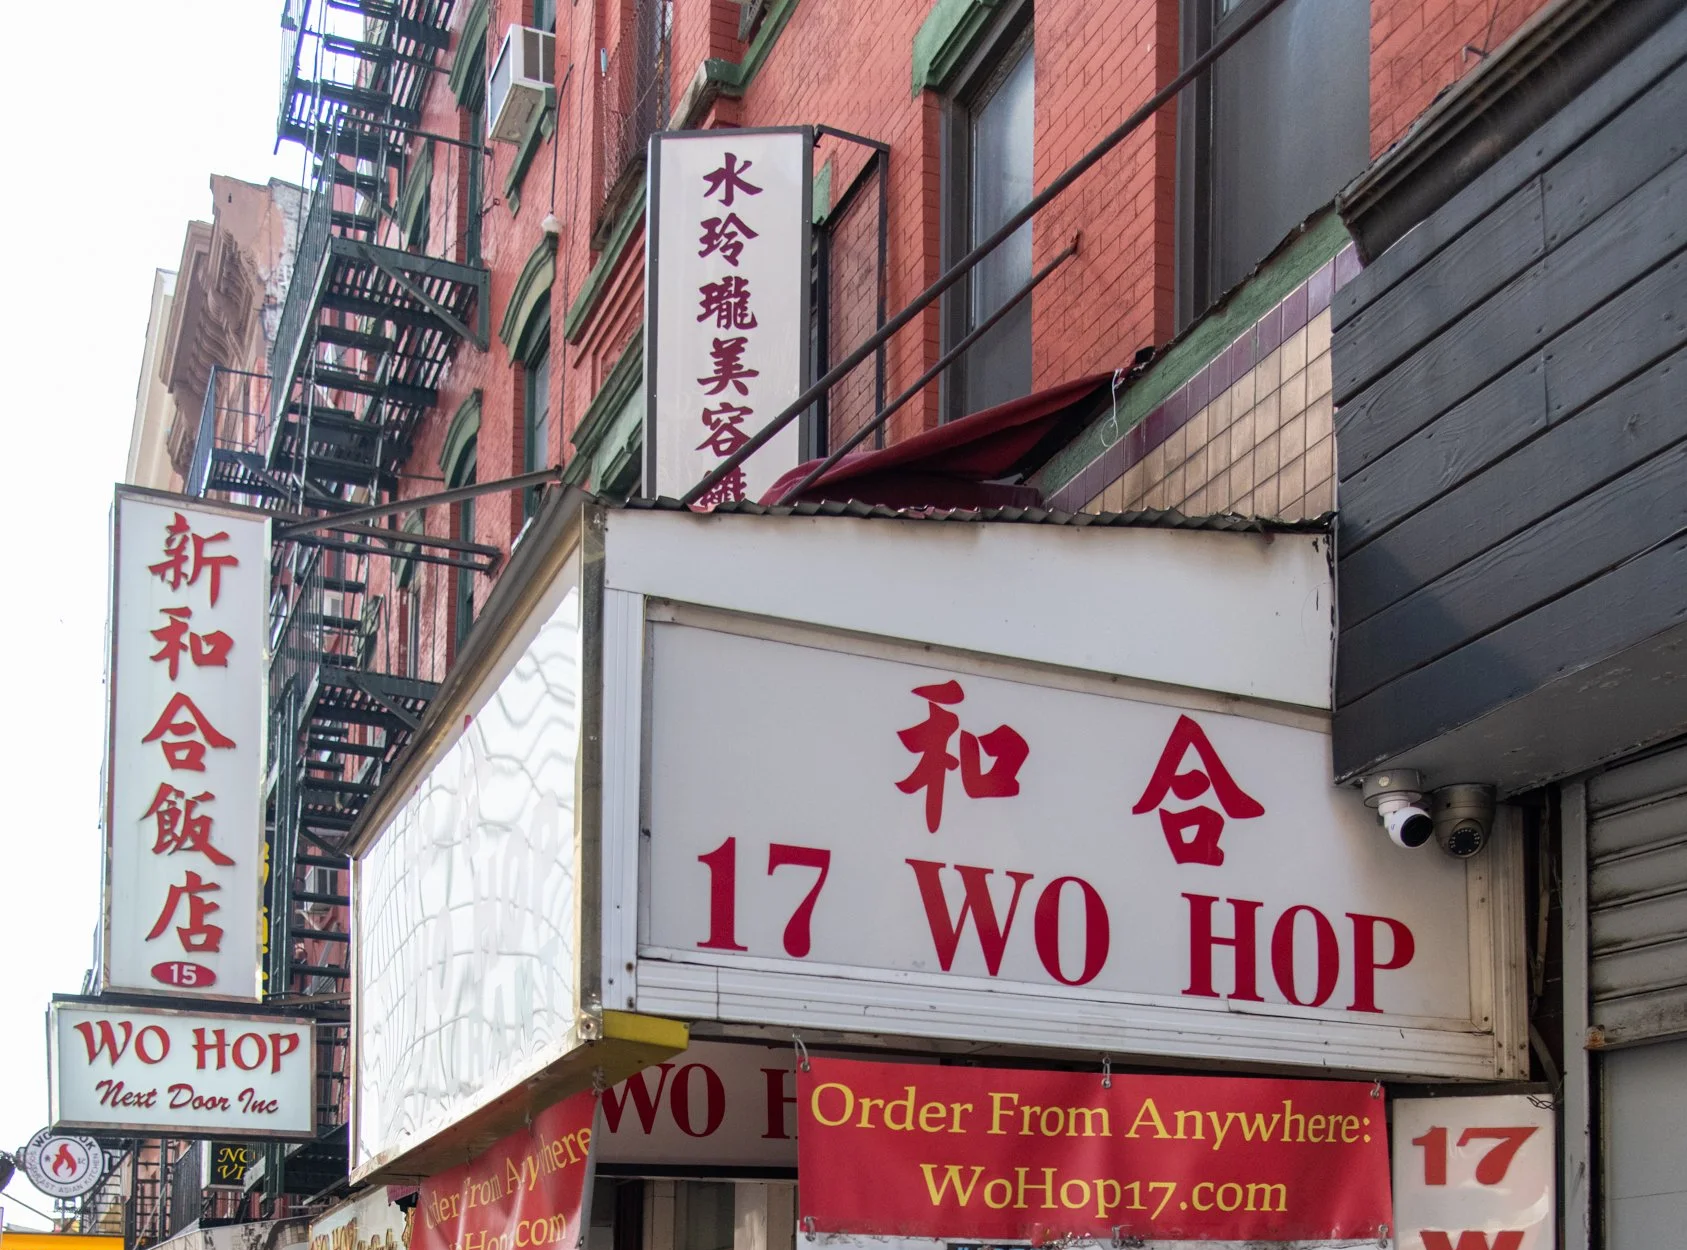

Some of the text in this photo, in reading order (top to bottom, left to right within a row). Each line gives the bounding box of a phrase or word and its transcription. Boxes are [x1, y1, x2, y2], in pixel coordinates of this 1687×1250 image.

[139, 511, 239, 953] 新和合飯店
[894, 679, 1265, 867] 和合
[696, 835, 1415, 1014] 17 WO HOP
[170, 964, 197, 985] 15
[74, 1020, 300, 1074] WO HOP
[95, 1079, 279, 1114] Next Door Inc
[811, 1082, 974, 1136] Order
[986, 1091, 1112, 1138] From
[1125, 1097, 1372, 1150] Anywhere:
[1412, 1127, 1539, 1186] 17
[920, 1163, 1288, 1220] WoHop17.com
